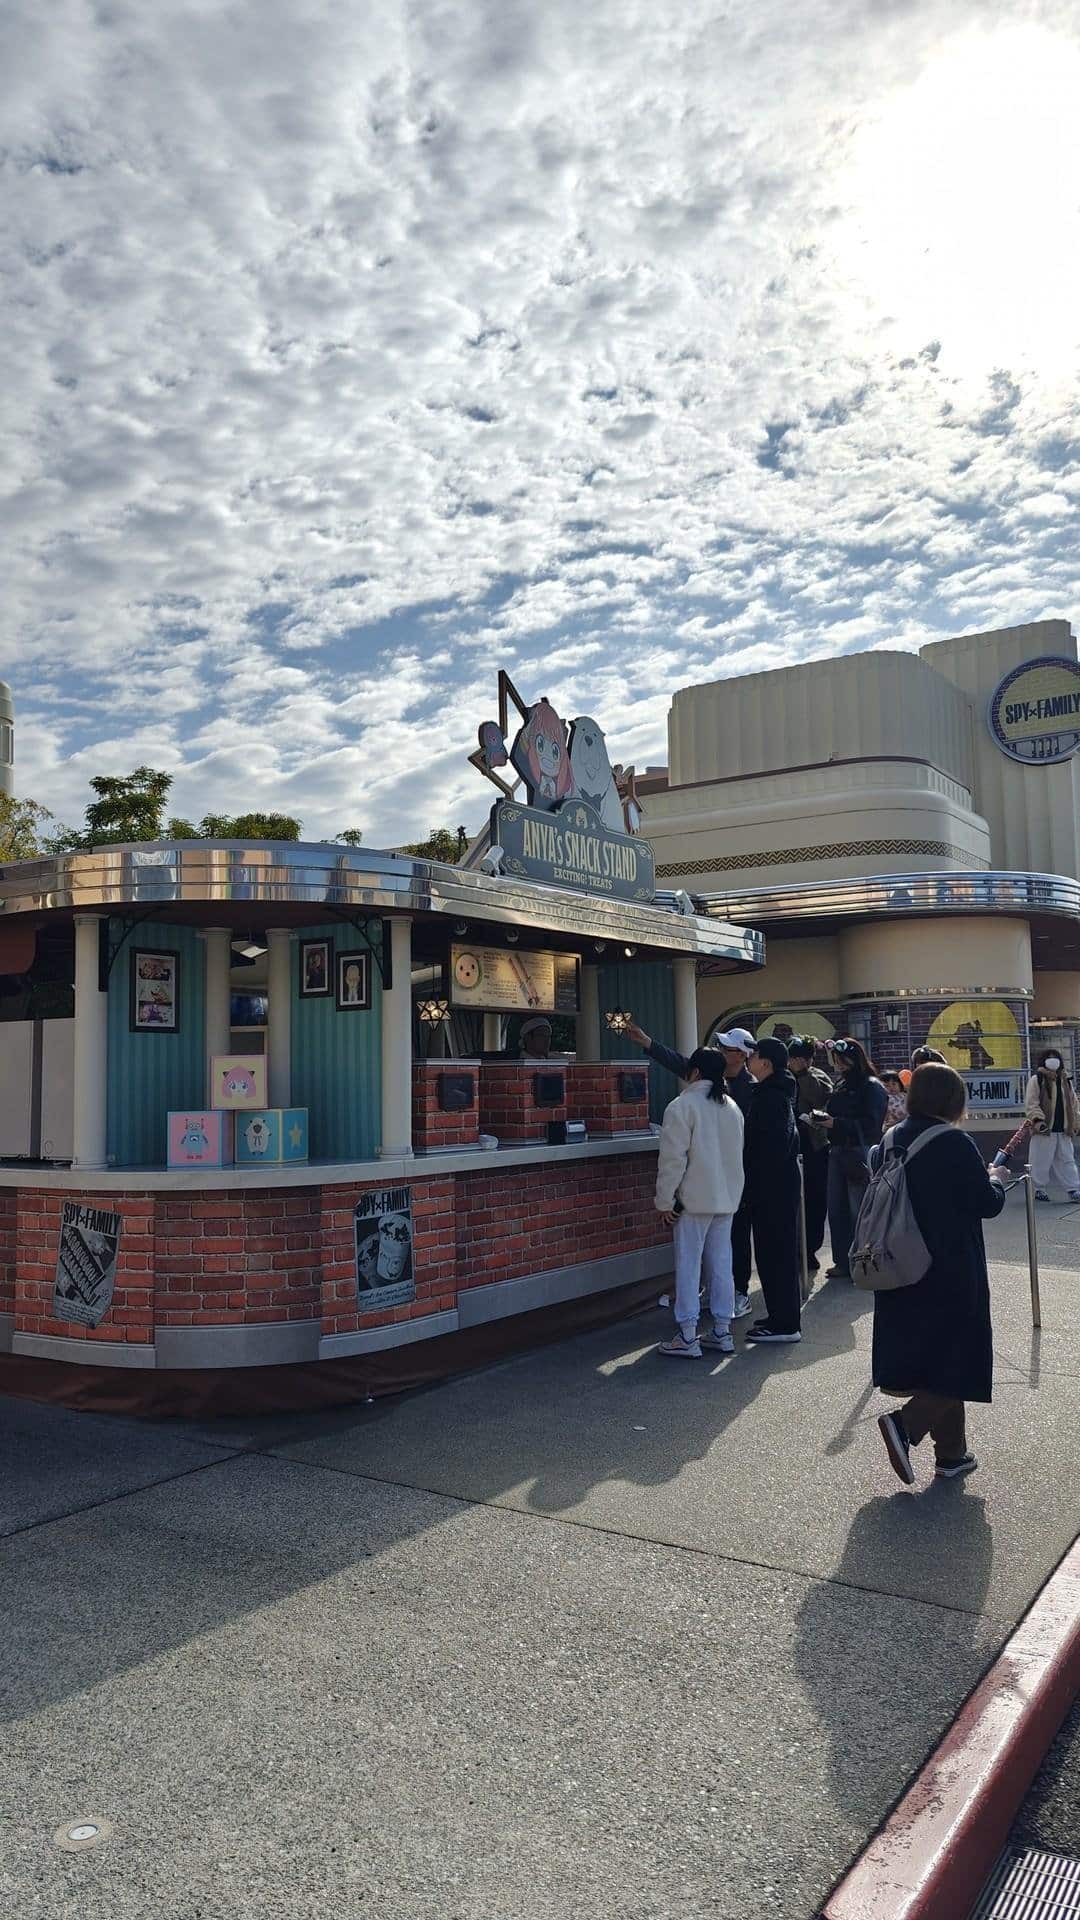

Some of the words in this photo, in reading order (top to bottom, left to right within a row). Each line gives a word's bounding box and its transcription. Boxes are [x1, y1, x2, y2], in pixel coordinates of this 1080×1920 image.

[565, 830, 601, 873] SNACK
[603, 841, 637, 882] STAND
[587, 874, 613, 890] TREATS
[967, 1081, 1010, 1100] Y×FAMILY
